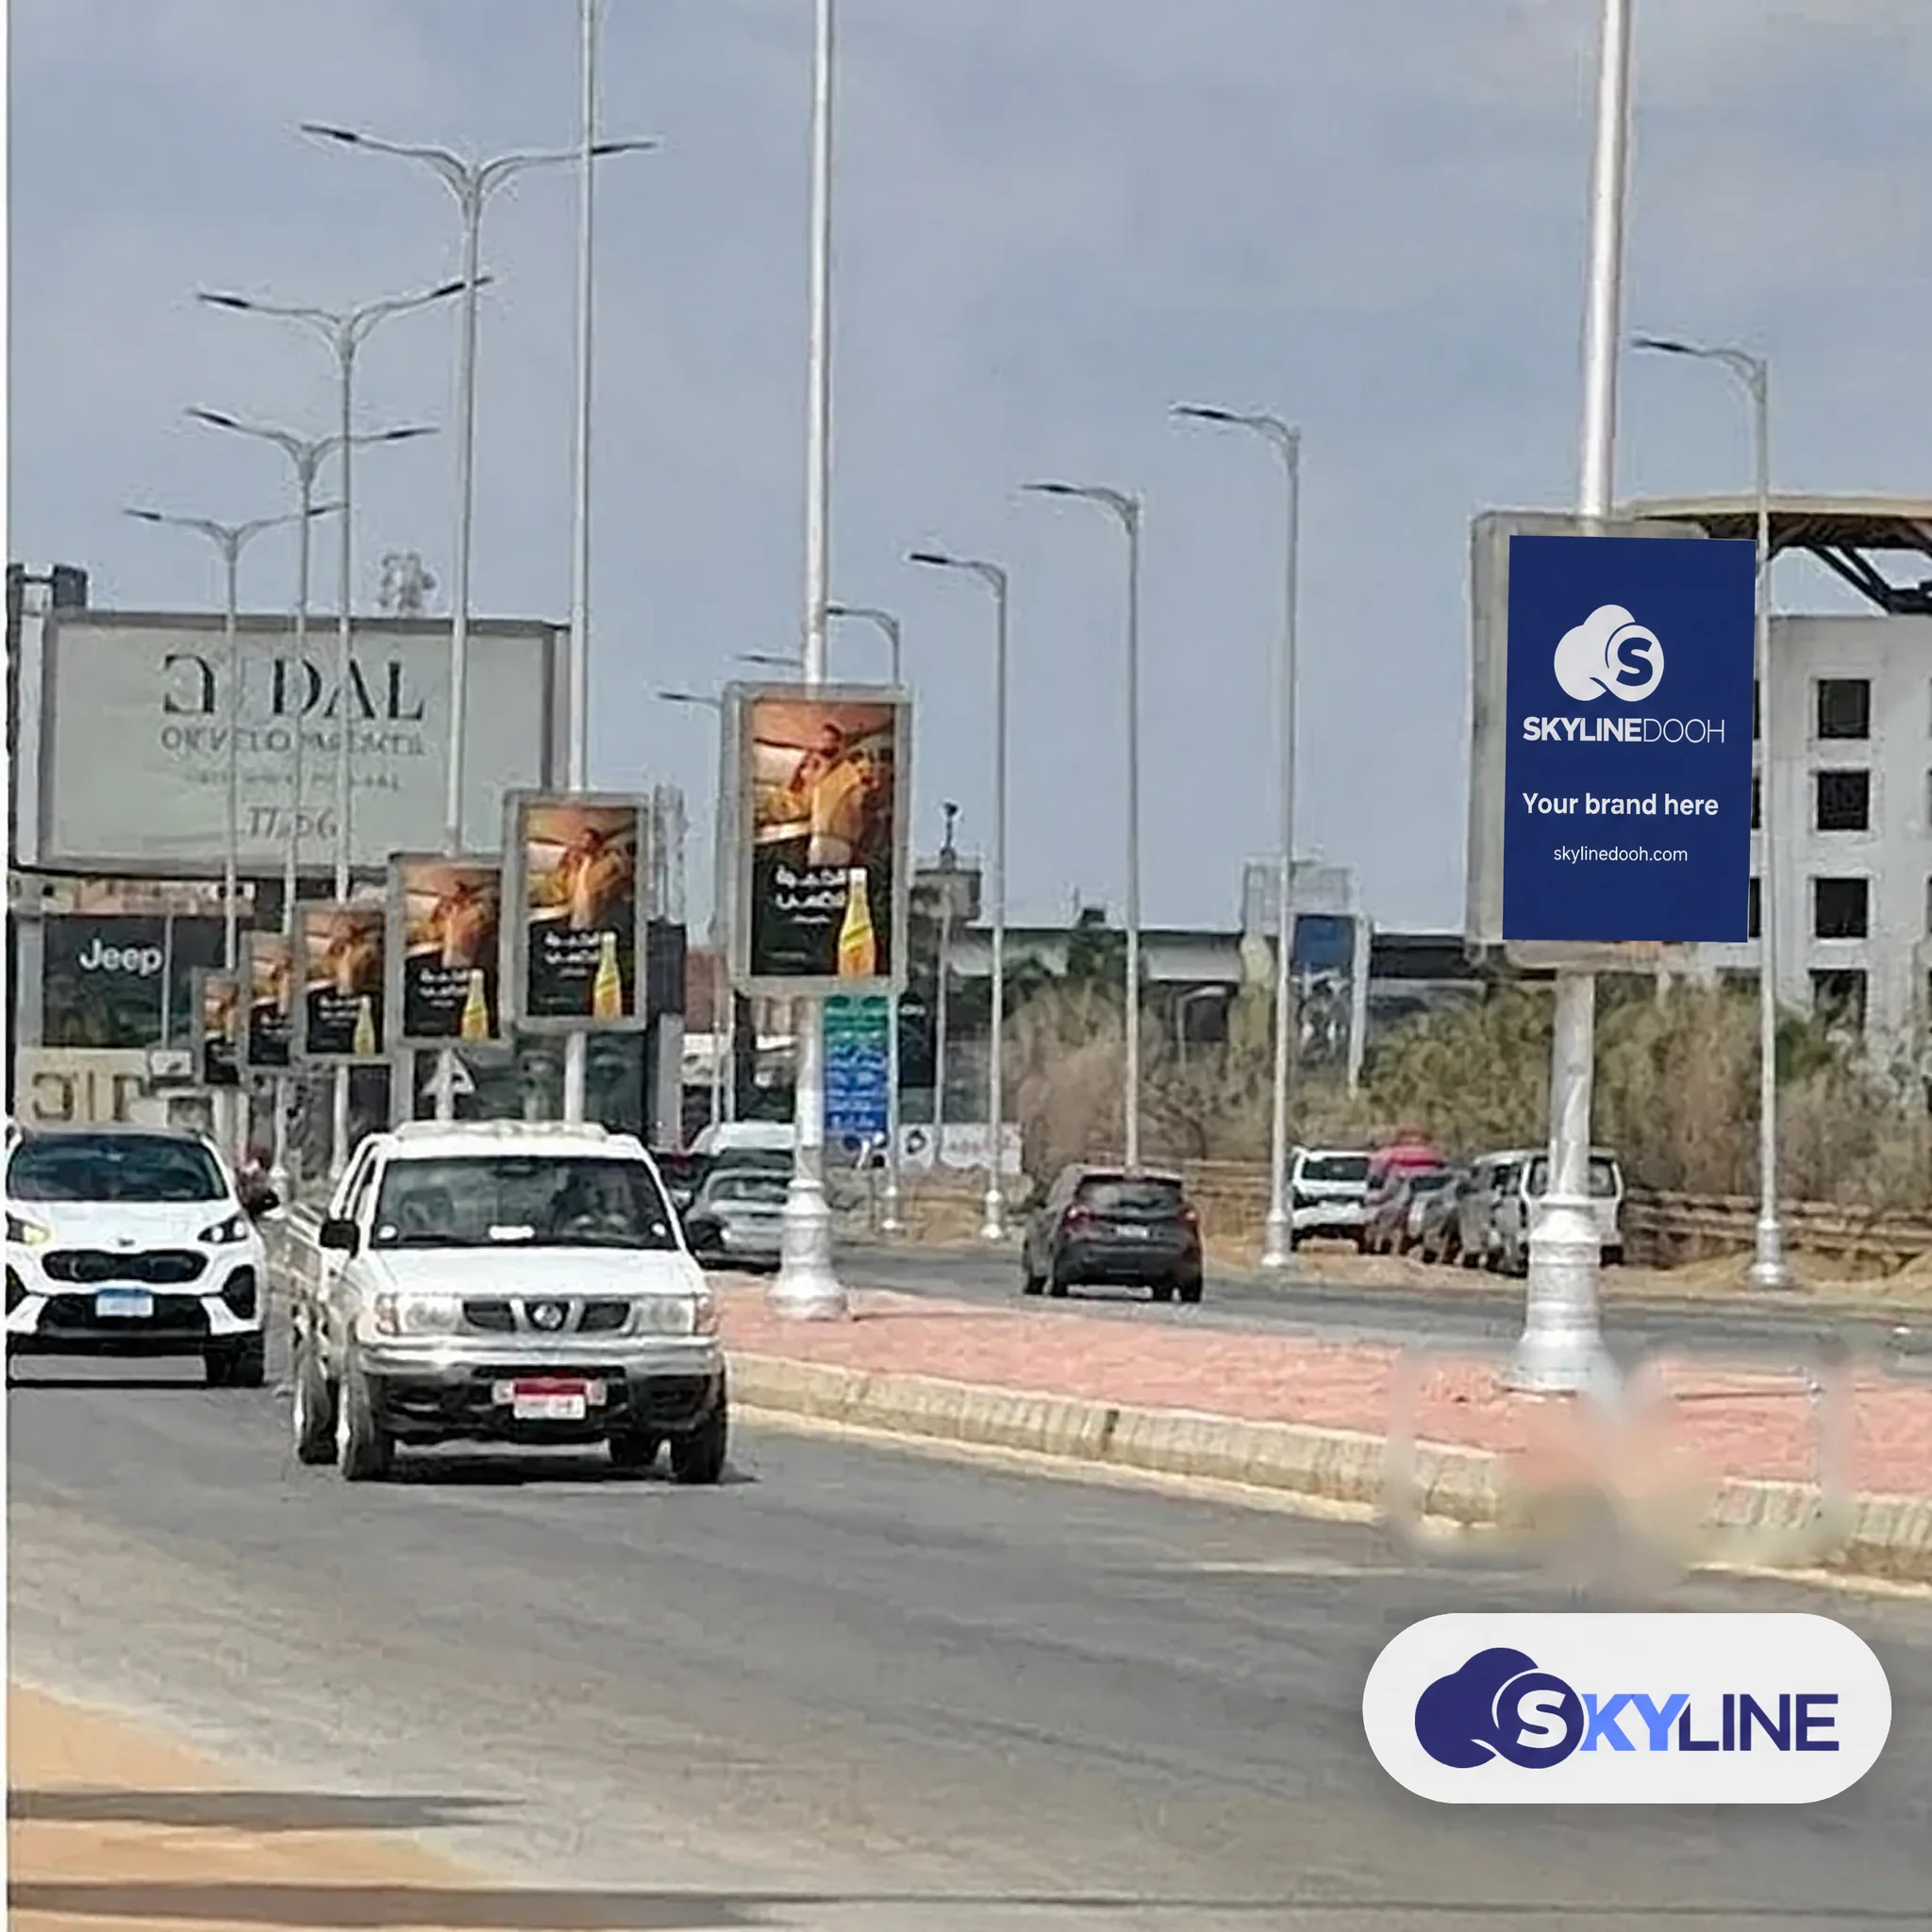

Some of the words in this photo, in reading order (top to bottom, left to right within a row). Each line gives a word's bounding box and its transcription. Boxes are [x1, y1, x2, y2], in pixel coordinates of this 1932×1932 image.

[1616, 637, 1654, 687] S
[1522, 716, 1725, 744] SKYLINEDOOH
[1523, 792, 1579, 815] Your
[1585, 792, 1657, 816] brand
[1664, 793, 1720, 817] here
[1553, 845, 1689, 865] skylinedooh.com
[79, 939, 162, 976] Jeep
